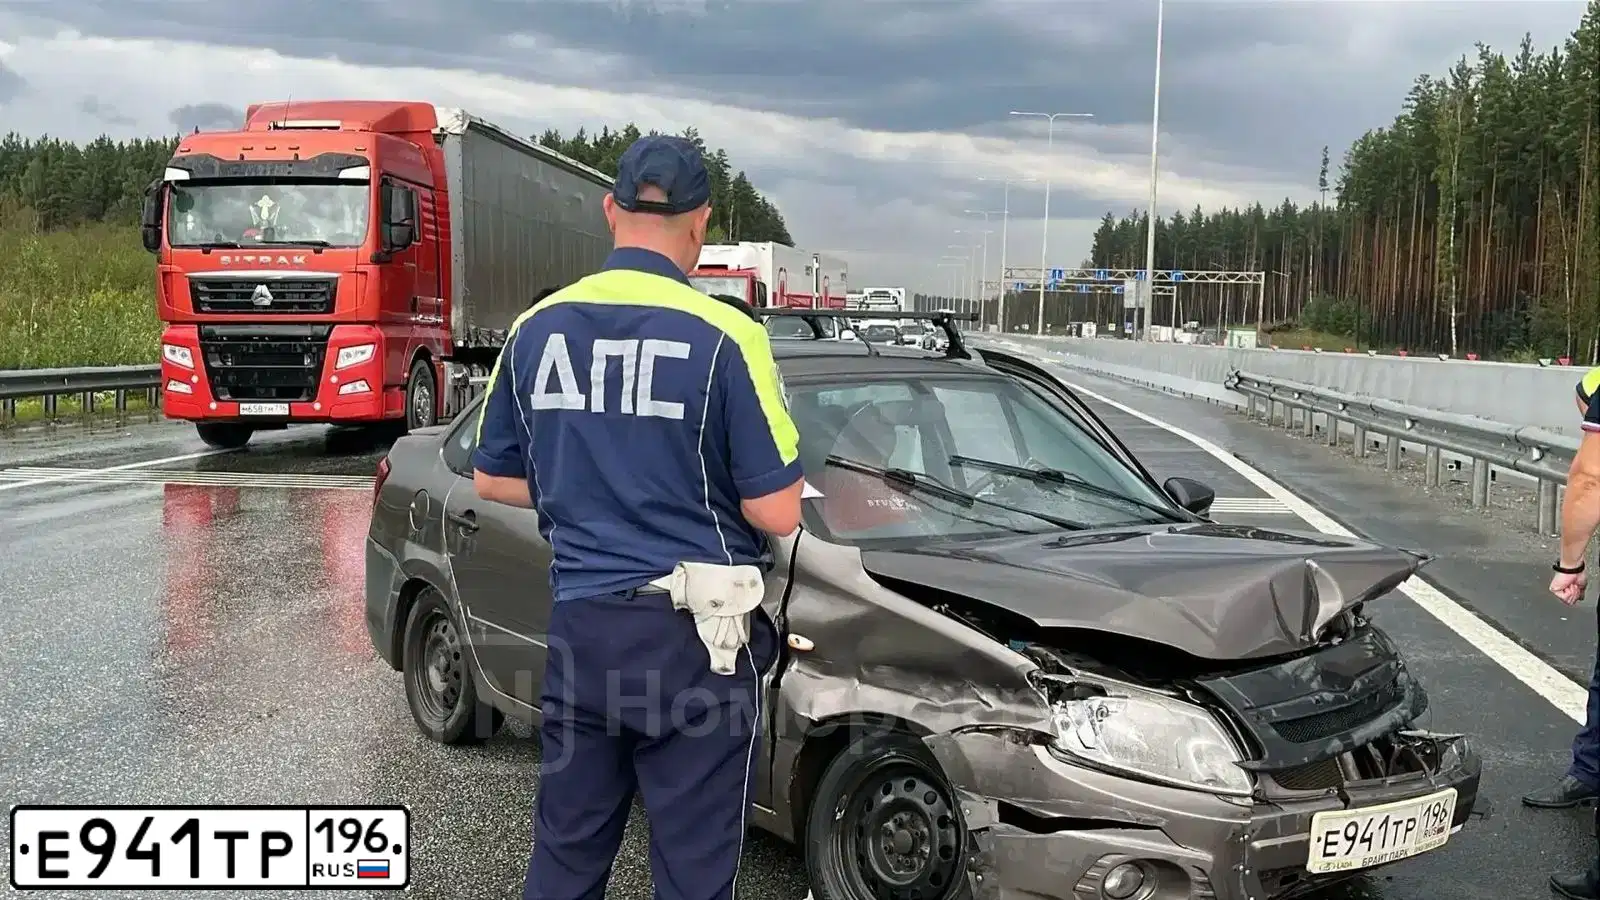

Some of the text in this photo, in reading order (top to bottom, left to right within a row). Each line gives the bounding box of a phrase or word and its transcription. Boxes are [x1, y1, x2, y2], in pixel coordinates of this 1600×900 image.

[220, 255, 308, 265] SITRAK
[530, 333, 691, 420] ДПС
[1423, 799, 1448, 828] 196
[1423, 826, 1437, 838] RUS
